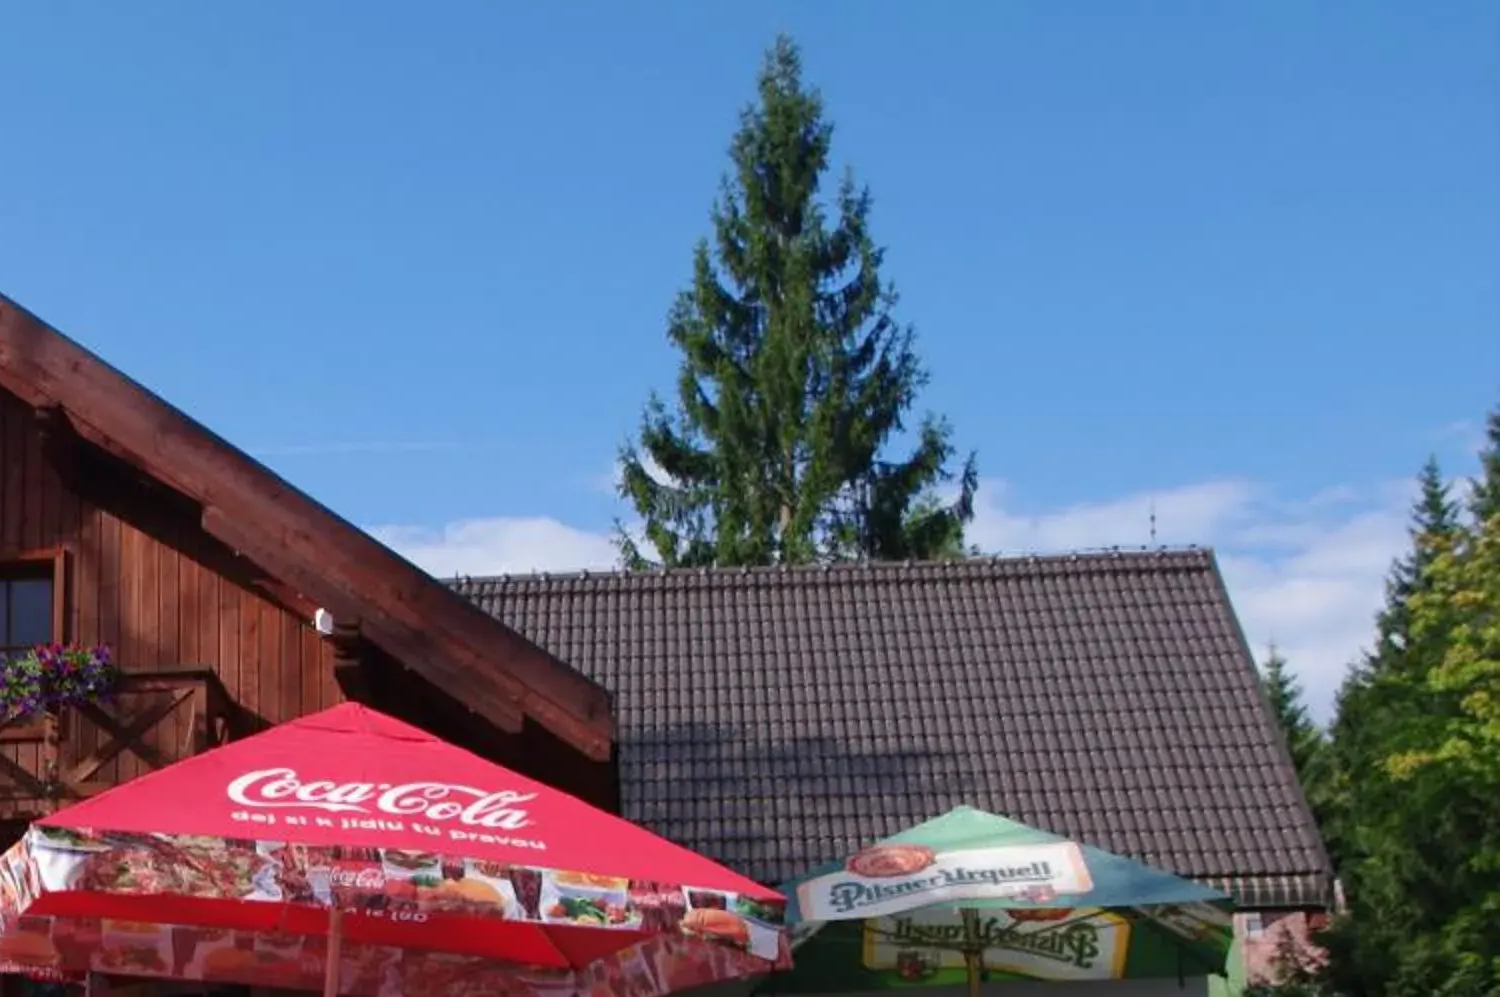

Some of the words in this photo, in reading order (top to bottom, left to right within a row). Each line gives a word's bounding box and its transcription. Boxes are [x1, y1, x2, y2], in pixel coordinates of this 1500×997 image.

[226, 767, 539, 829] Coca-Cola
[448, 828, 547, 851] pravou
[828, 876, 938, 913] Pilsner
[938, 861, 1052, 885] Urquell
